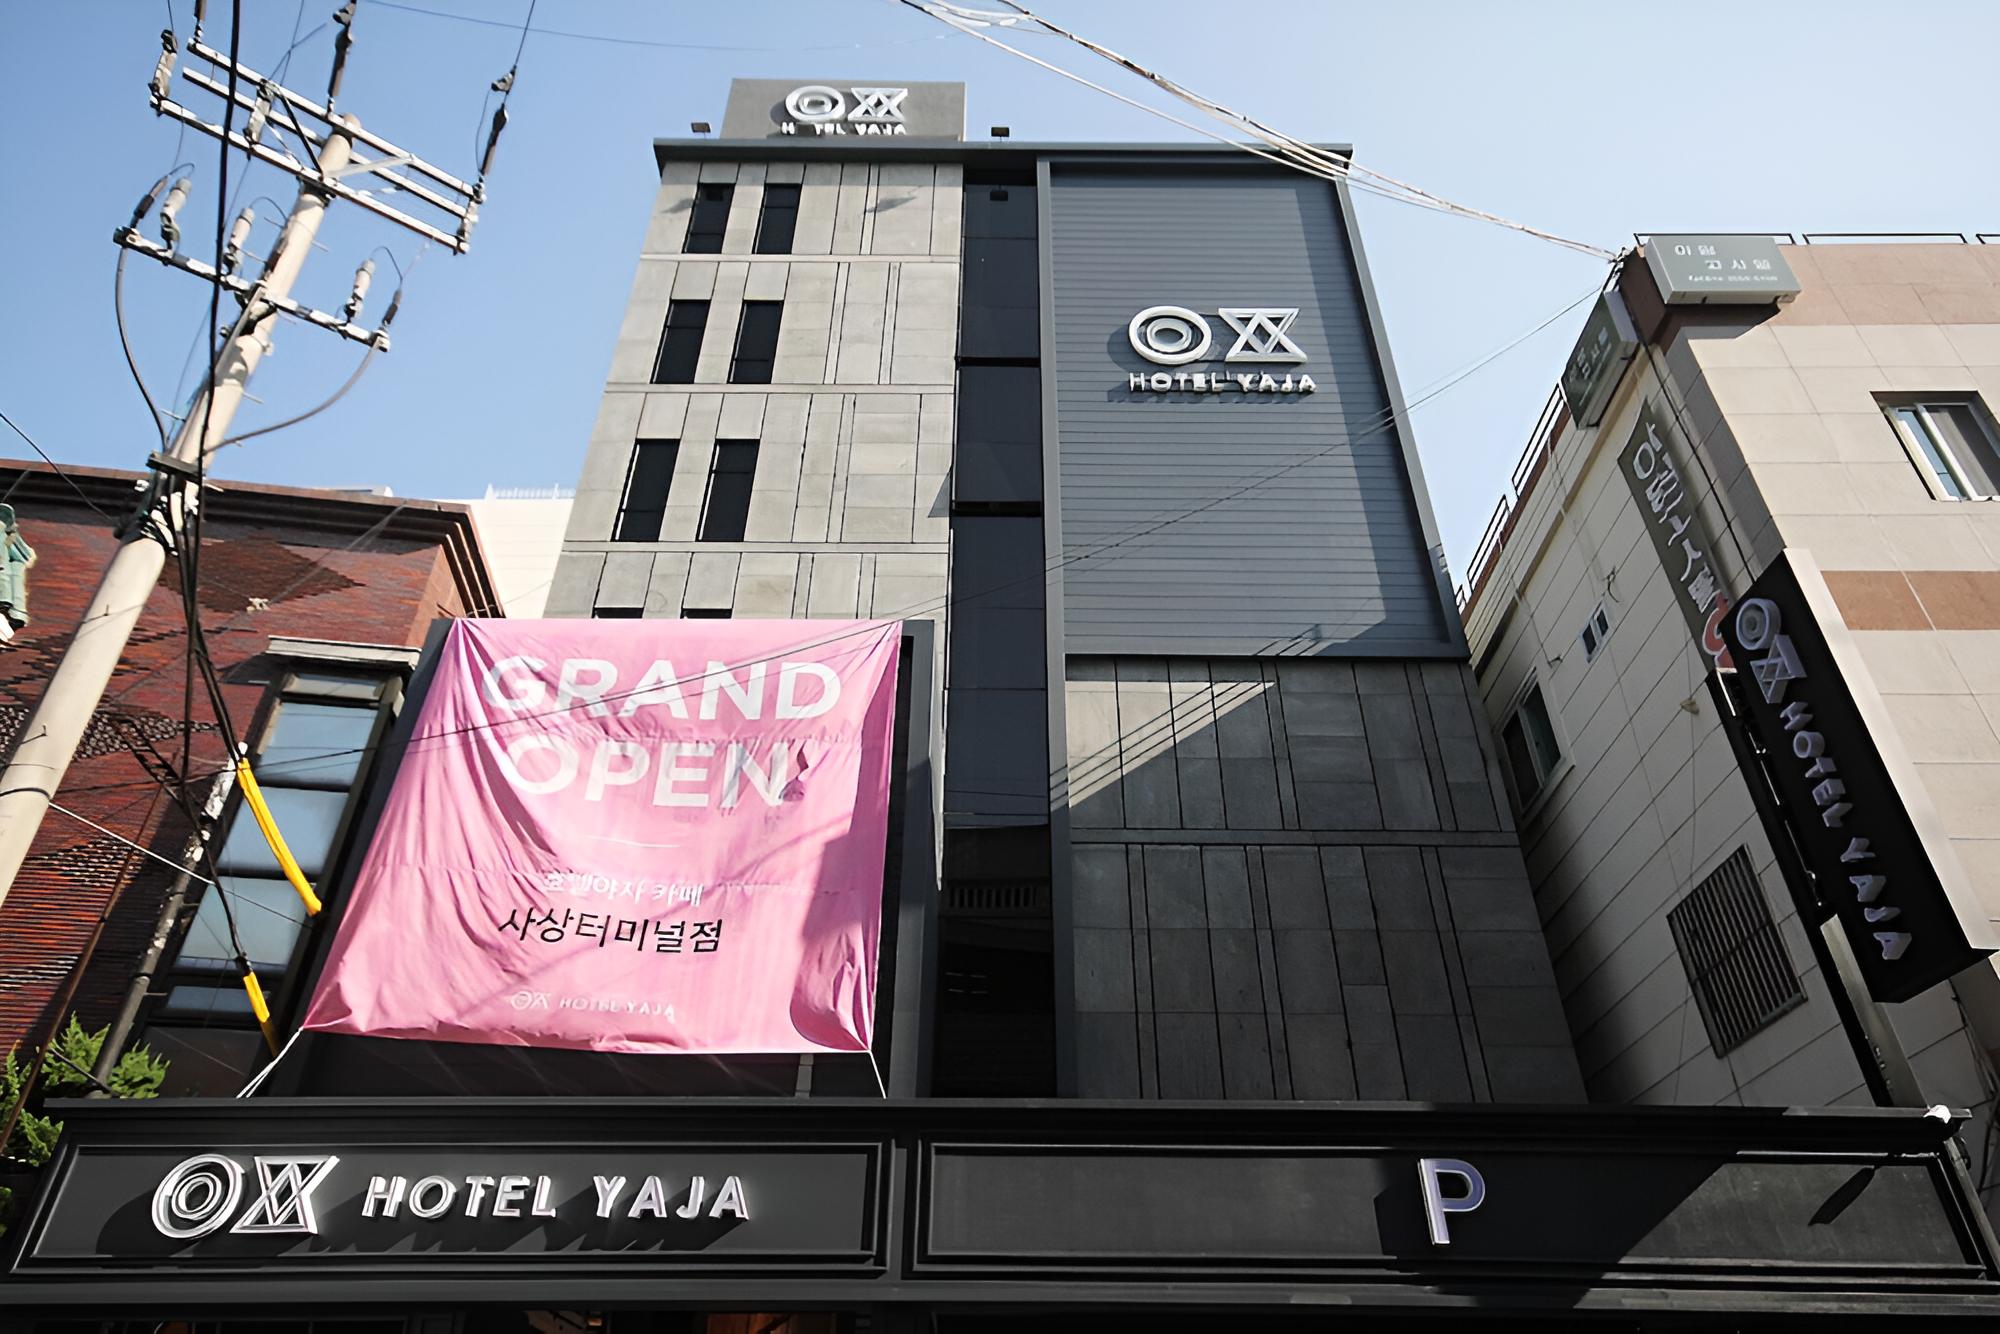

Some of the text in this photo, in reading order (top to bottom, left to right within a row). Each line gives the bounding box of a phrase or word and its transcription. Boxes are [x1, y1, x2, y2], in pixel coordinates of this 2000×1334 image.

[1129, 371, 1317, 392] HOTEL YAJA
[481, 655, 842, 722] GRAND
[506, 734, 789, 809] OPEN
[1779, 701, 1854, 828] HOTEL
[1840, 836, 1913, 961] YAJA
[498, 906, 723, 953] 사상터미널점
[559, 996, 621, 1013] HOTEL
[626, 1000, 676, 1024] YAJA
[361, 1174, 557, 1220] HOTEL
[593, 1175, 750, 1221] YAJA
[1417, 1157, 1486, 1245] P
